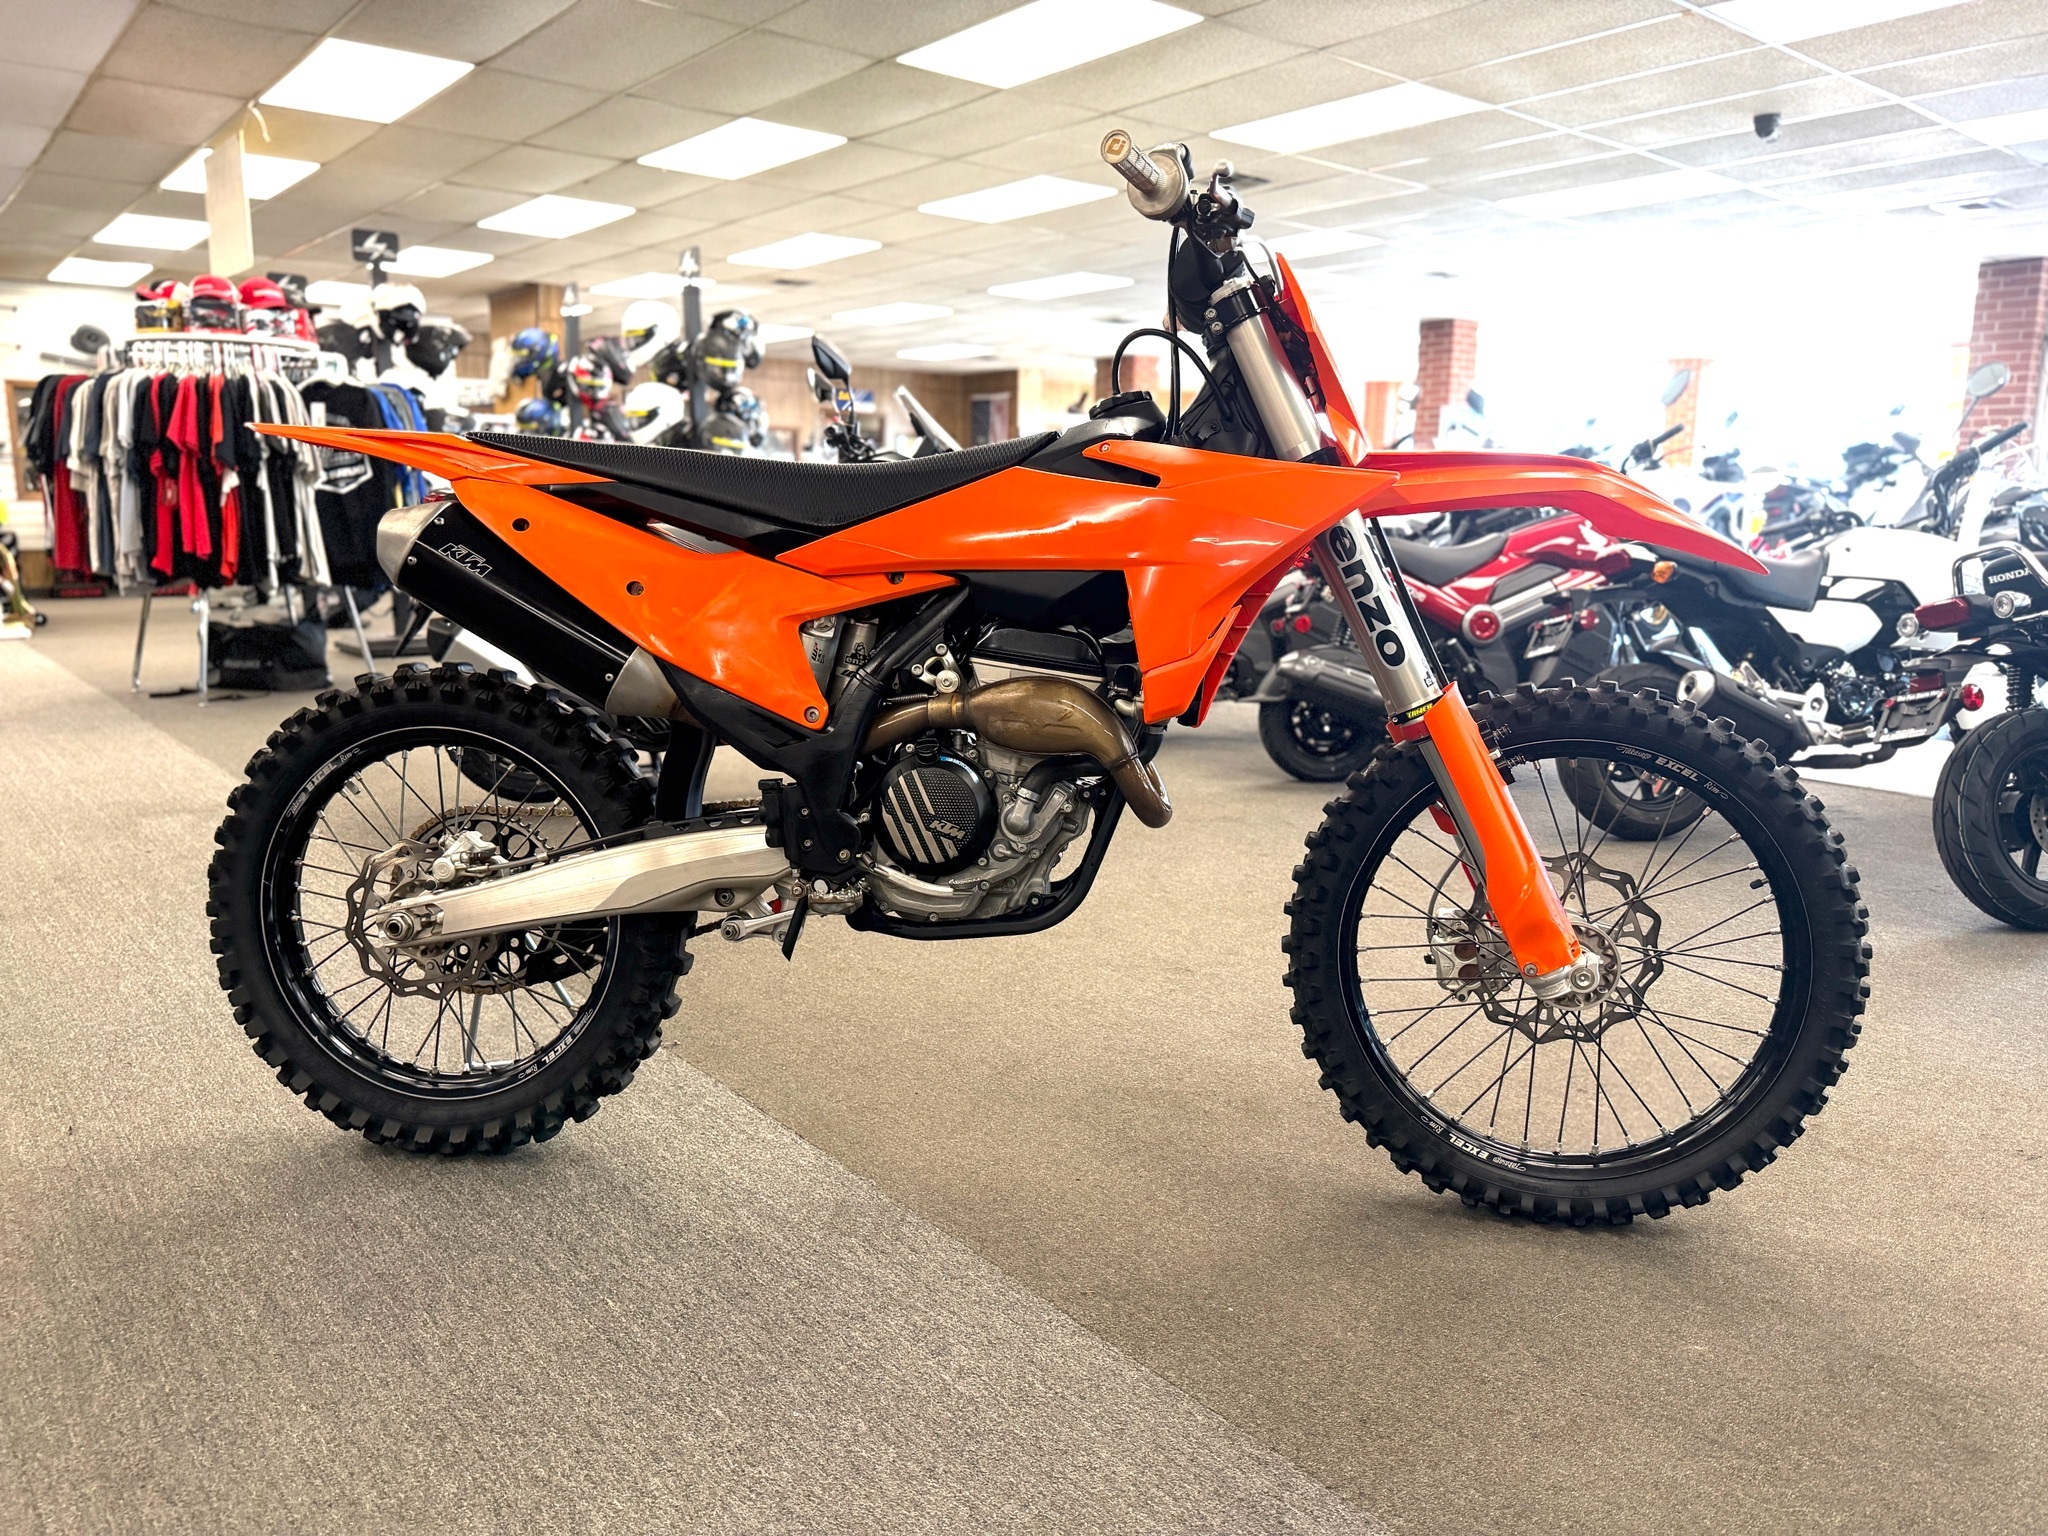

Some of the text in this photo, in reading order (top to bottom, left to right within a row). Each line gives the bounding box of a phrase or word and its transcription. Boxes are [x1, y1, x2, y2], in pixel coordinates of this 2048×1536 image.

[438, 542, 493, 578] KTM
[1988, 567, 2032, 584] HONDA
[1329, 526, 1405, 667] enzo
[306, 763, 337, 791] EXCEL
[1655, 756, 1698, 782] EXCEL
[1703, 781, 1725, 797] Rim
[930, 820, 966, 839] KTM
[541, 1034, 573, 1063] EXCEL
[1424, 1118, 1443, 1134] Rim
[1449, 1133, 1489, 1160] EXCEL
